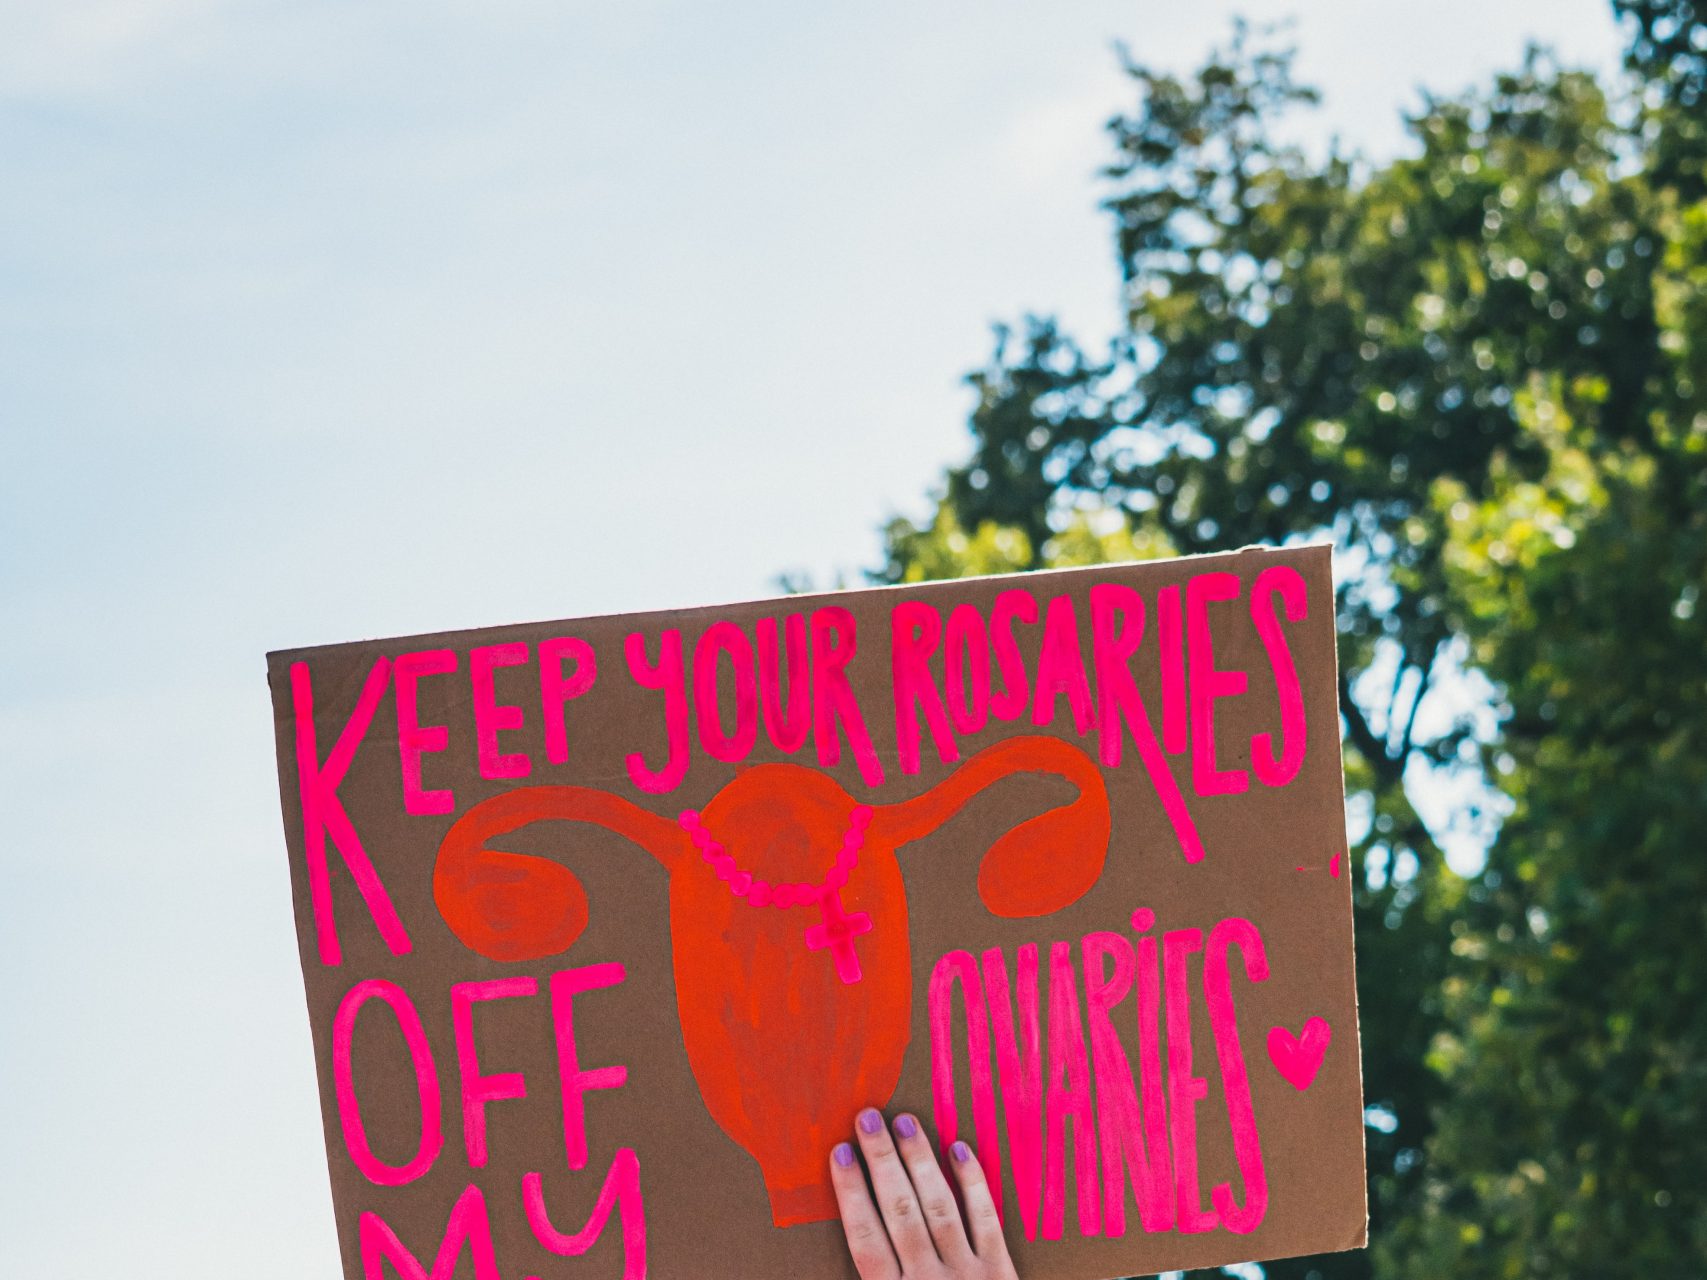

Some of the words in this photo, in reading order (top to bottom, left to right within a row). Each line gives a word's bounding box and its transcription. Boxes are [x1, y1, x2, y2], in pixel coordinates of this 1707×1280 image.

[290, 637, 598, 966] KEEP
[624, 606, 885, 794] YOUR
[891, 565, 1308, 864] ROSARIES
[333, 962, 628, 1187] OFF
